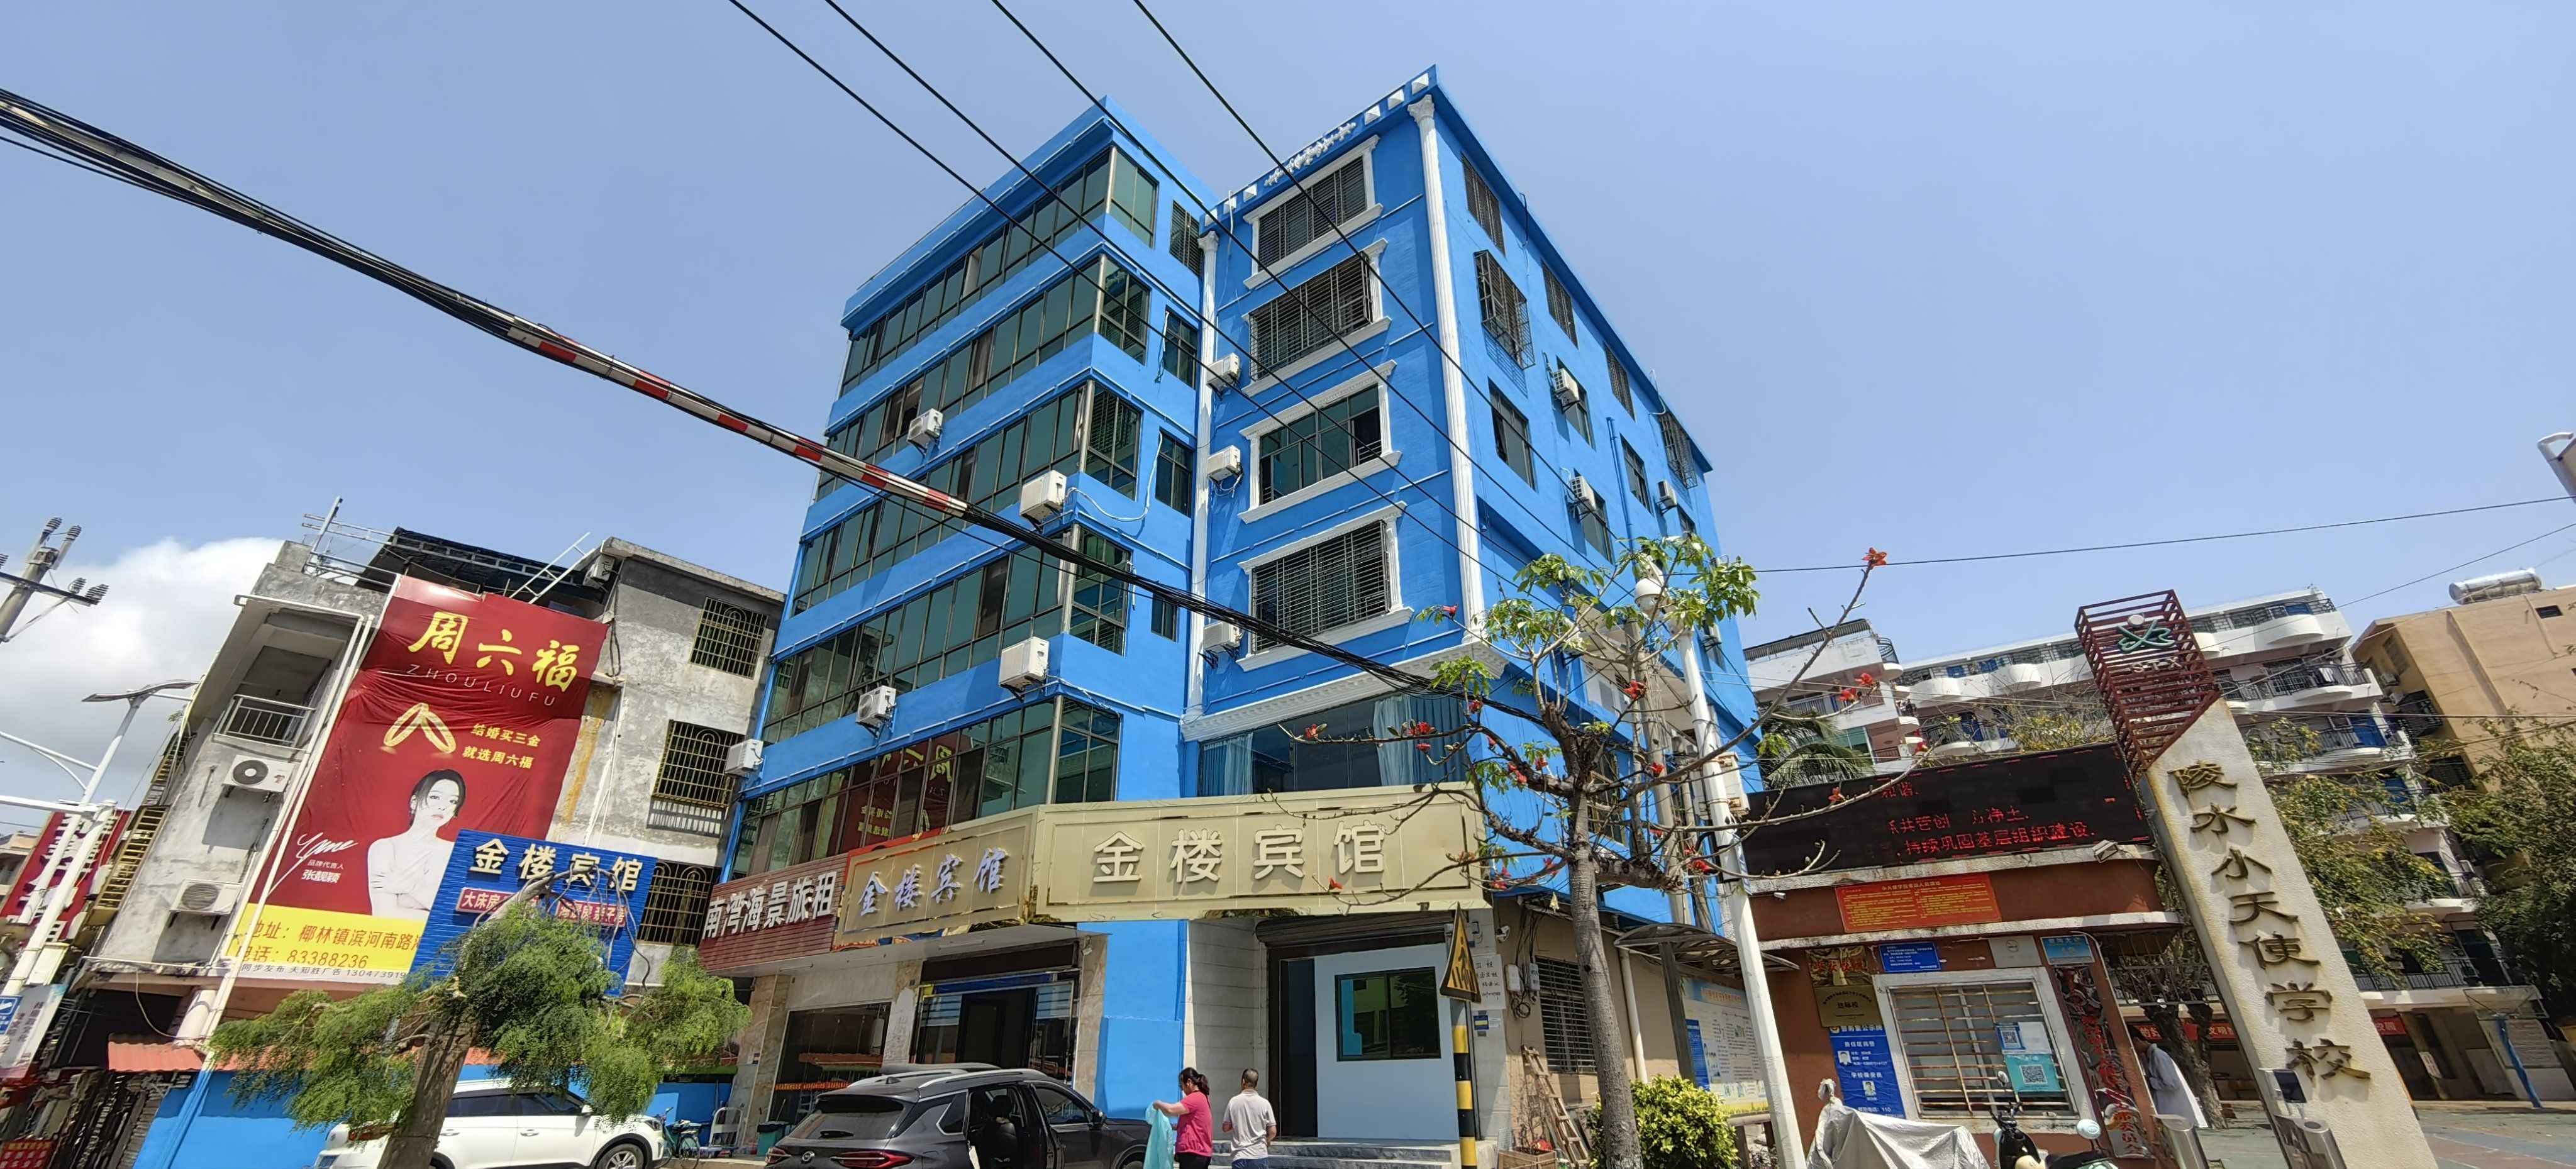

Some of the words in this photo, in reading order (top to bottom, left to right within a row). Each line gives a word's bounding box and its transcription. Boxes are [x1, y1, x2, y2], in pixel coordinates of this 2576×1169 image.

[408, 611, 579, 692] 周六福
[407, 664, 556, 706] ZHOULIUFU
[462, 746, 534, 769] 就选周六福
[471, 723, 541, 747] 结婚买三金
[308, 859, 344, 870] 品牌代言人
[469, 838, 643, 891] 金楼宾馆
[1093, 819, 1386, 883] 金楼宾馆
[301, 869, 341, 884] 张靓颖
[857, 846, 1008, 917] 金楼宾馆
[702, 871, 838, 939] 南湾海景旅租
[2167, 760, 2372, 1083] 陵水小天使学校
[347, 969, 407, 978] 130473919
